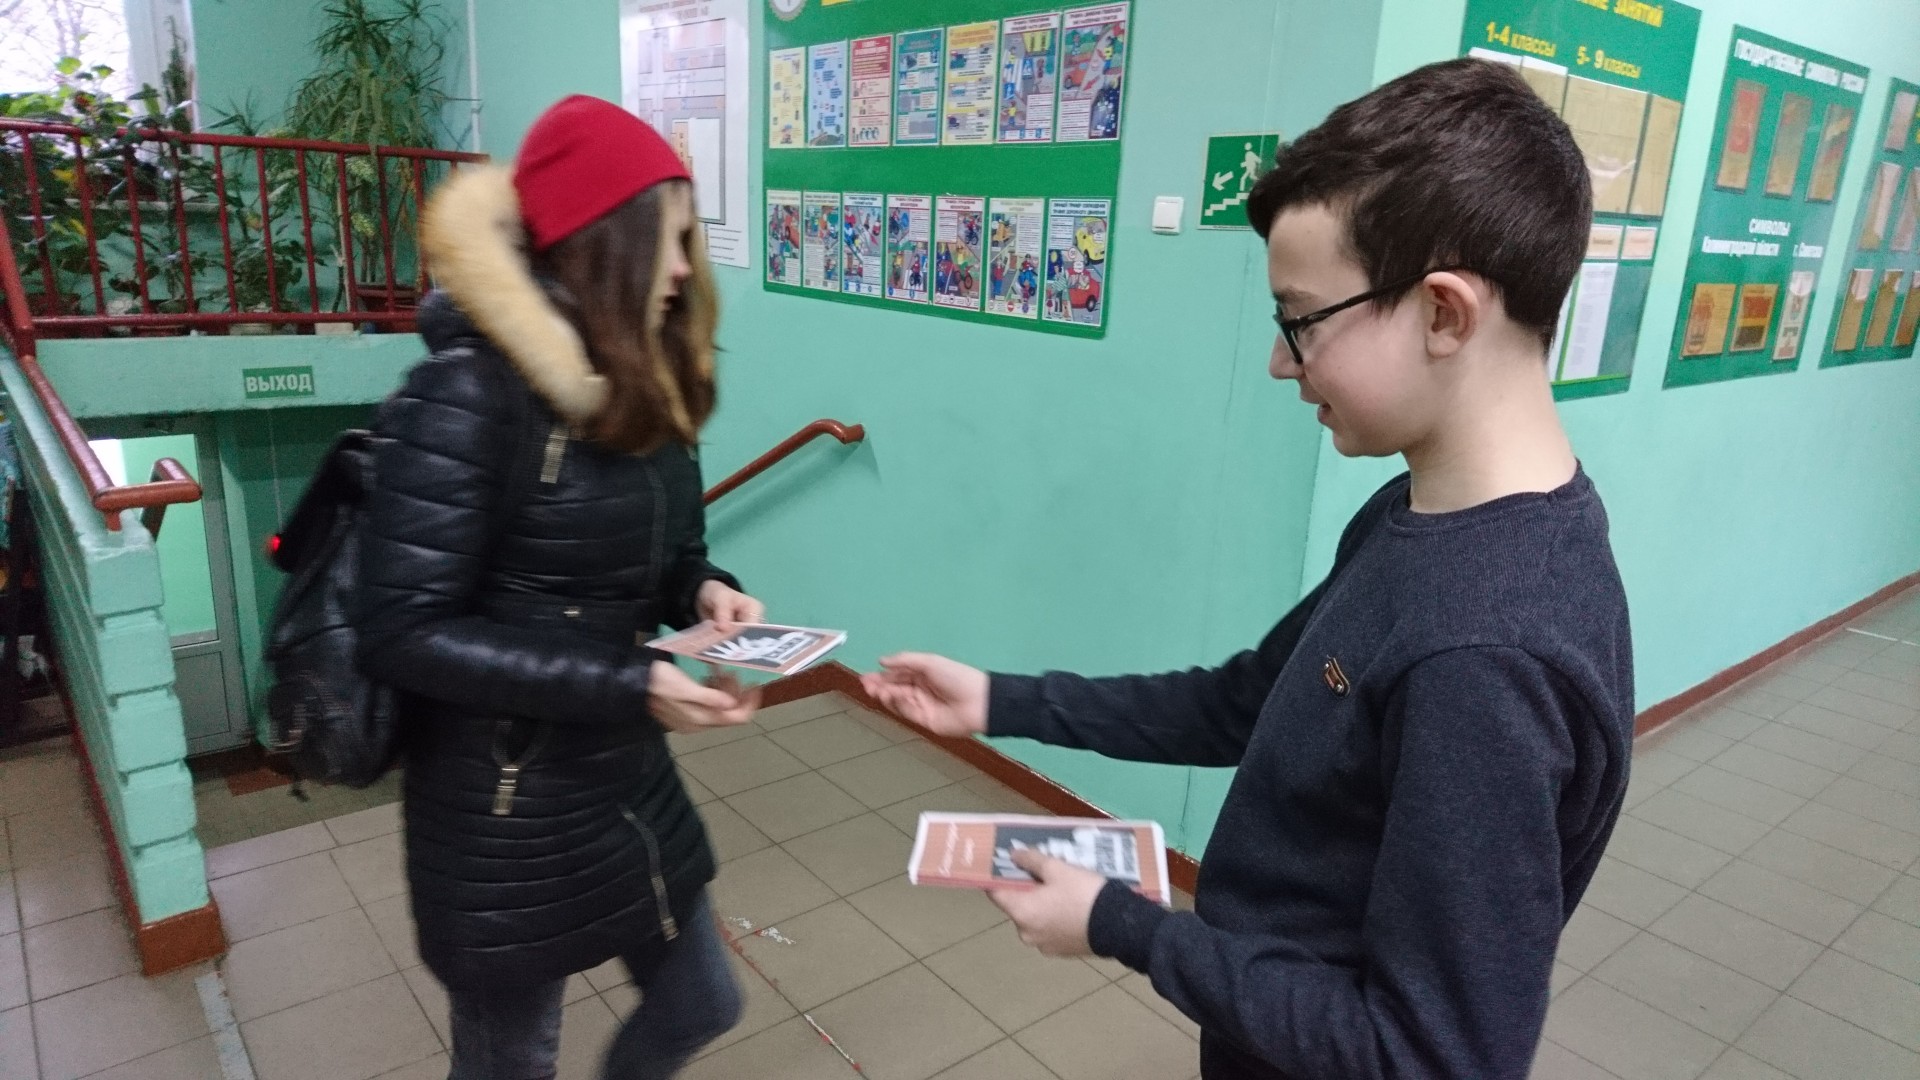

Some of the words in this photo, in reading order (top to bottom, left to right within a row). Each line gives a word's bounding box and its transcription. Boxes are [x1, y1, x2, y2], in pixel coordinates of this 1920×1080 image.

[1486, 21, 1511, 46] 1-4
[1511, 33, 1557, 58] классы
[246, 373, 312, 392] ВЫХОД
